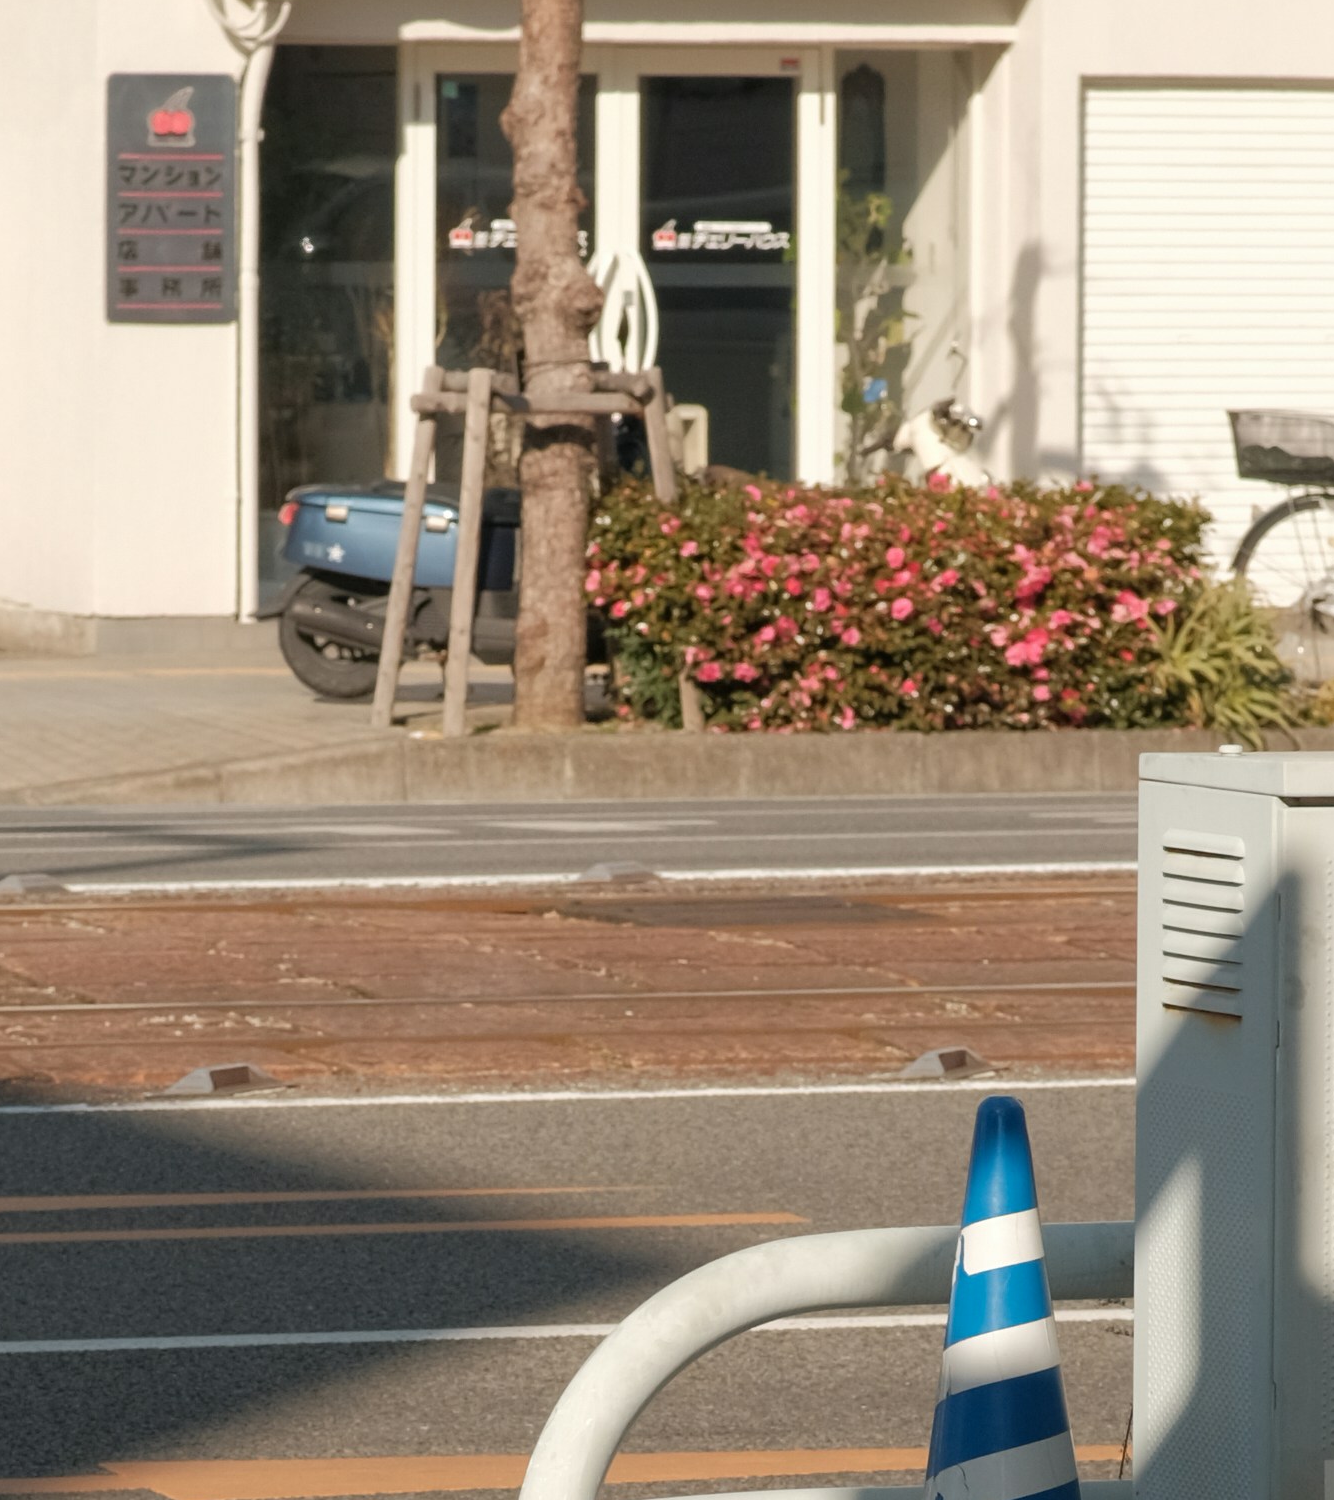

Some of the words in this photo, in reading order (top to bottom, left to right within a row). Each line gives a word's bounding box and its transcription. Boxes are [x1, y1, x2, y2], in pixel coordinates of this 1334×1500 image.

[118, 165, 222, 187] マンション
[119, 203, 221, 224] アパート
